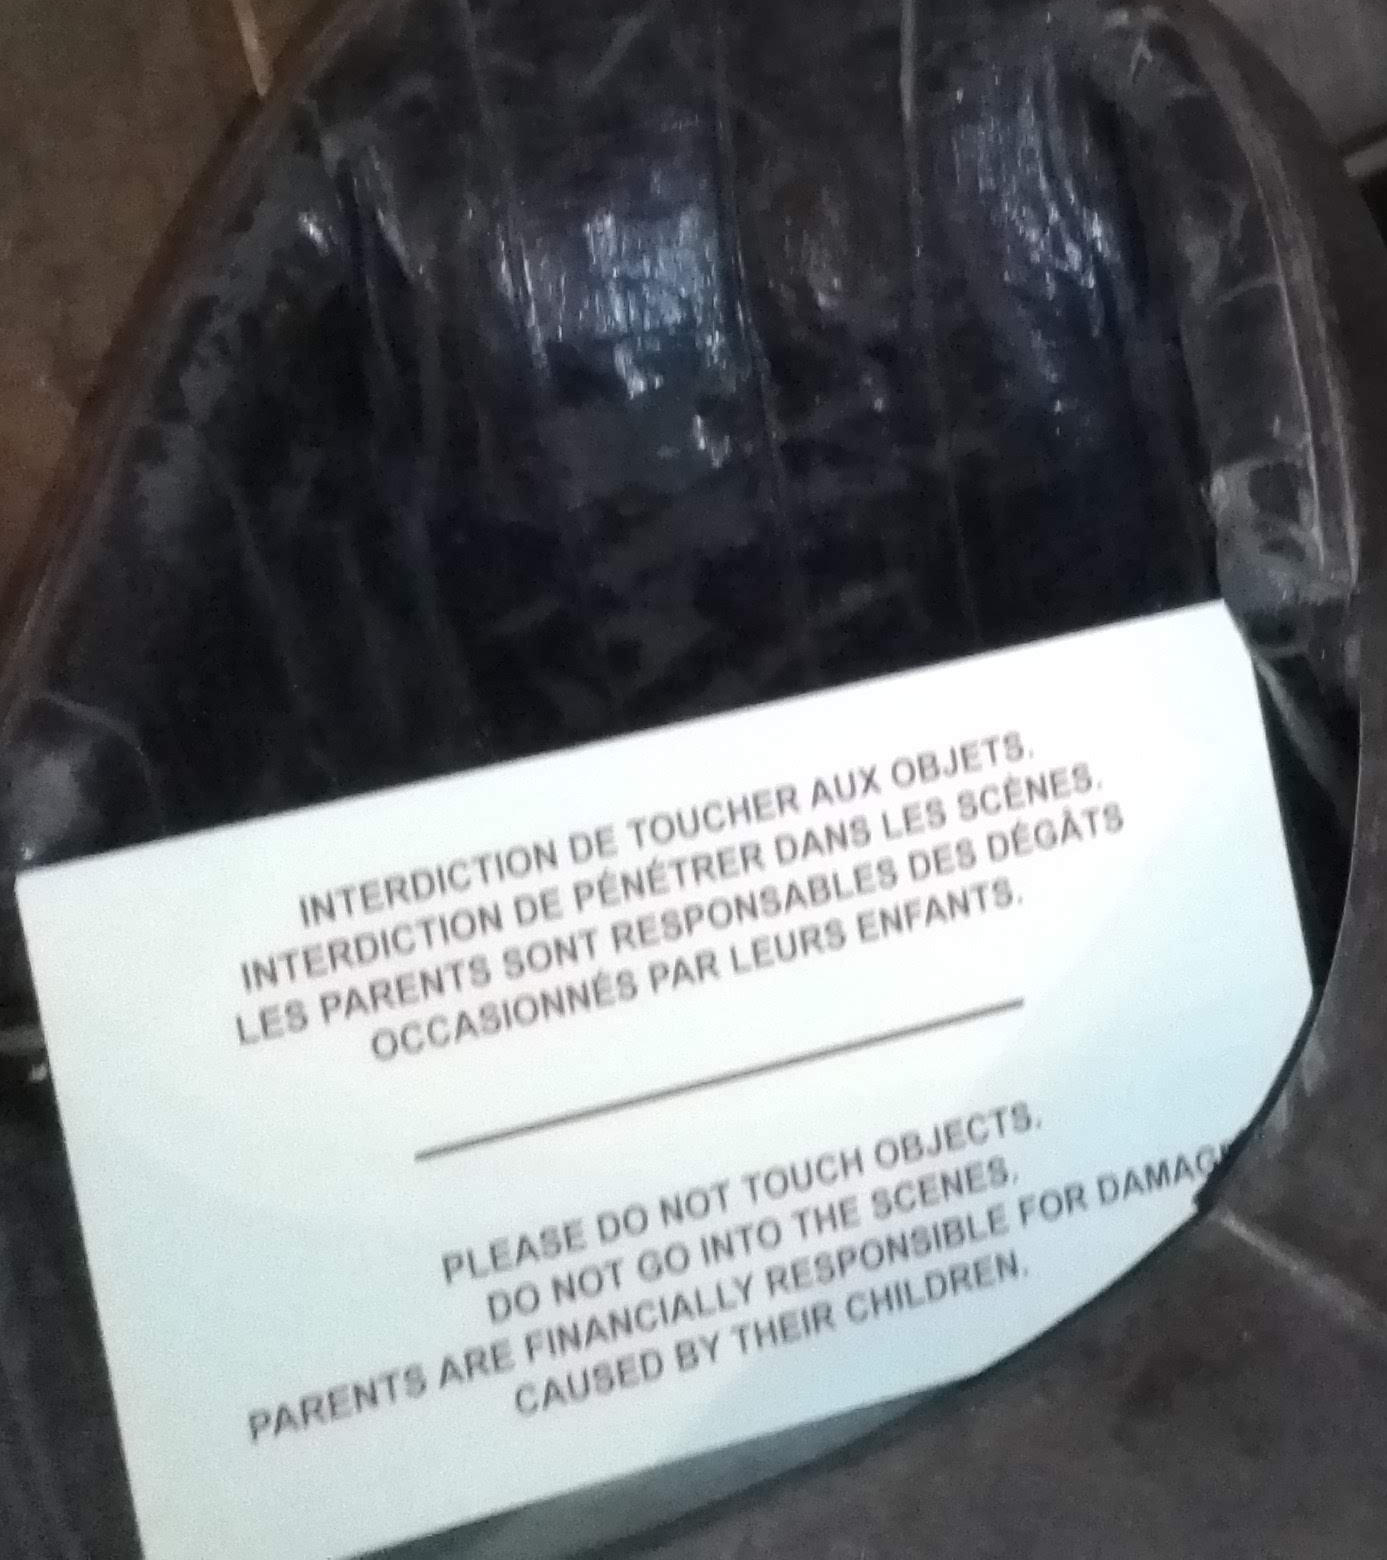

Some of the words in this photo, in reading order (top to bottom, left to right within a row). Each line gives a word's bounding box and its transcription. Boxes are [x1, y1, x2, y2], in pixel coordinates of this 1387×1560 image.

[235, 997, 309, 1047] LES
[319, 952, 492, 1025] PARENTS
[502, 926, 599, 980] SONT
[610, 855, 898, 954] RESPONSABLES
[908, 838, 977, 882] DES
[986, 801, 1125, 862] DÉGÂTS
[240, 902, 503, 993] INTERDICTION
[513, 886, 564, 927] DE
[573, 840, 766, 913] PÉNÉTRER
[774, 813, 872, 866] DANS
[881, 796, 947, 840] LES
[957, 761, 1103, 822] SCÈNES.
[300, 839, 558, 928] INTERDICTION
[568, 824, 620, 864] DE
[626, 782, 801, 850] TOUCHER
[811, 765, 882, 809] AUX
[891, 730, 1035, 788] OBJETS.
[371, 967, 639, 1062] OCCASIONNÉS
[648, 949, 721, 995] PAR
[730, 918, 847, 975] LEURS
[856, 876, 1023, 943] ENFANTS.
[441, 1217, 587, 1285] PLEASE
[596, 1202, 649, 1242] DO
[658, 1178, 732, 1226] NOT
[743, 1144, 865, 1205] TOUCH
[873, 1100, 1042, 1170] OBJECTS.
[486, 1281, 541, 1325] DO
[550, 1258, 625, 1307] NOT
[636, 1241, 690, 1282] GO
[699, 1218, 782, 1265] INTO
[791, 1196, 860, 1240] THE
[870, 1156, 1019, 1220] SCENES.
[248, 1363, 428, 1446] PARENTS
[438, 1342, 516, 1389] ARE
[523, 1272, 754, 1364] FINANCIALLY
[764, 1201, 1011, 1299] RESPONSIBLE
[1018, 1186, 1088, 1226] FOR
[1097, 1143, 1231, 1206] DAMAG
[514, 1349, 665, 1417] CAUSED
[674, 1331, 721, 1373] BY
[731, 1301, 836, 1355] THEIR
[845, 1247, 1029, 1325] CHILDREN.
